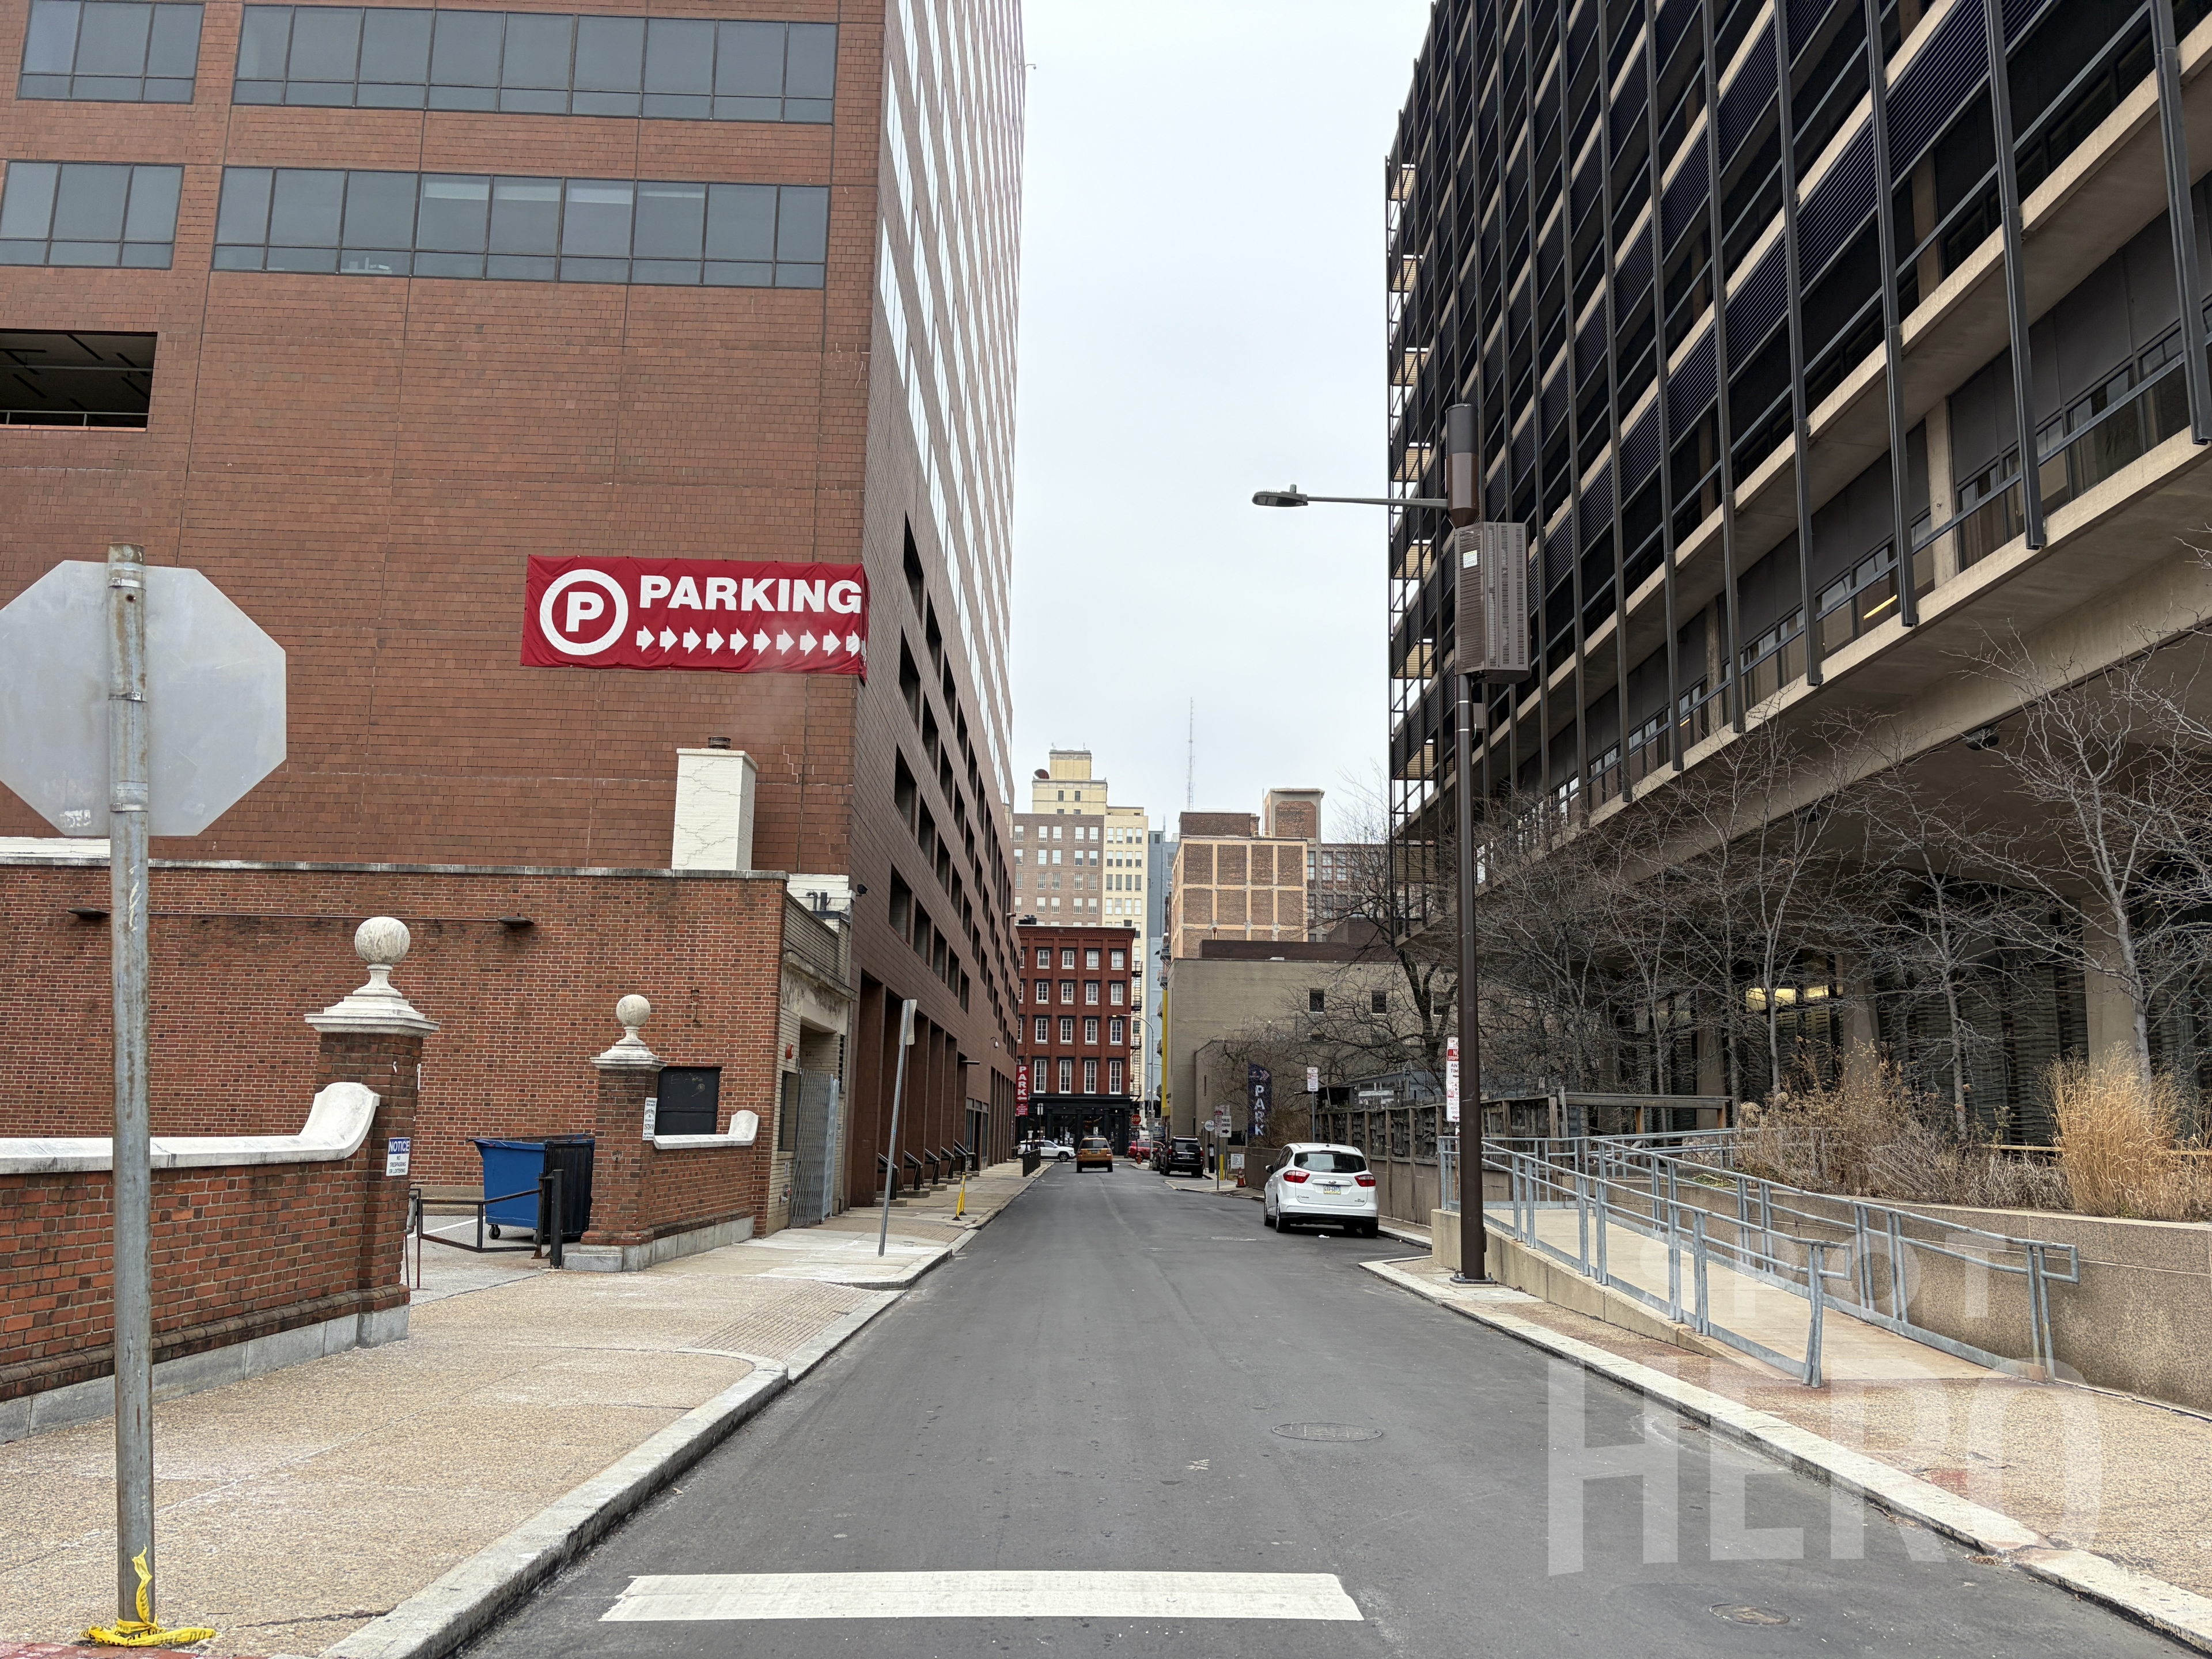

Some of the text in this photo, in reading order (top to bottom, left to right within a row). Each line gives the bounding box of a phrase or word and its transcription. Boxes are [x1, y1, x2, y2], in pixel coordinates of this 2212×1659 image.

[566, 591, 604, 632] P
[639, 575, 862, 614] PARKING
[1017, 1066, 1027, 1096] PARK
[1254, 1085, 1266, 1137] PARK
[389, 1141, 410, 1152] NOTICE
